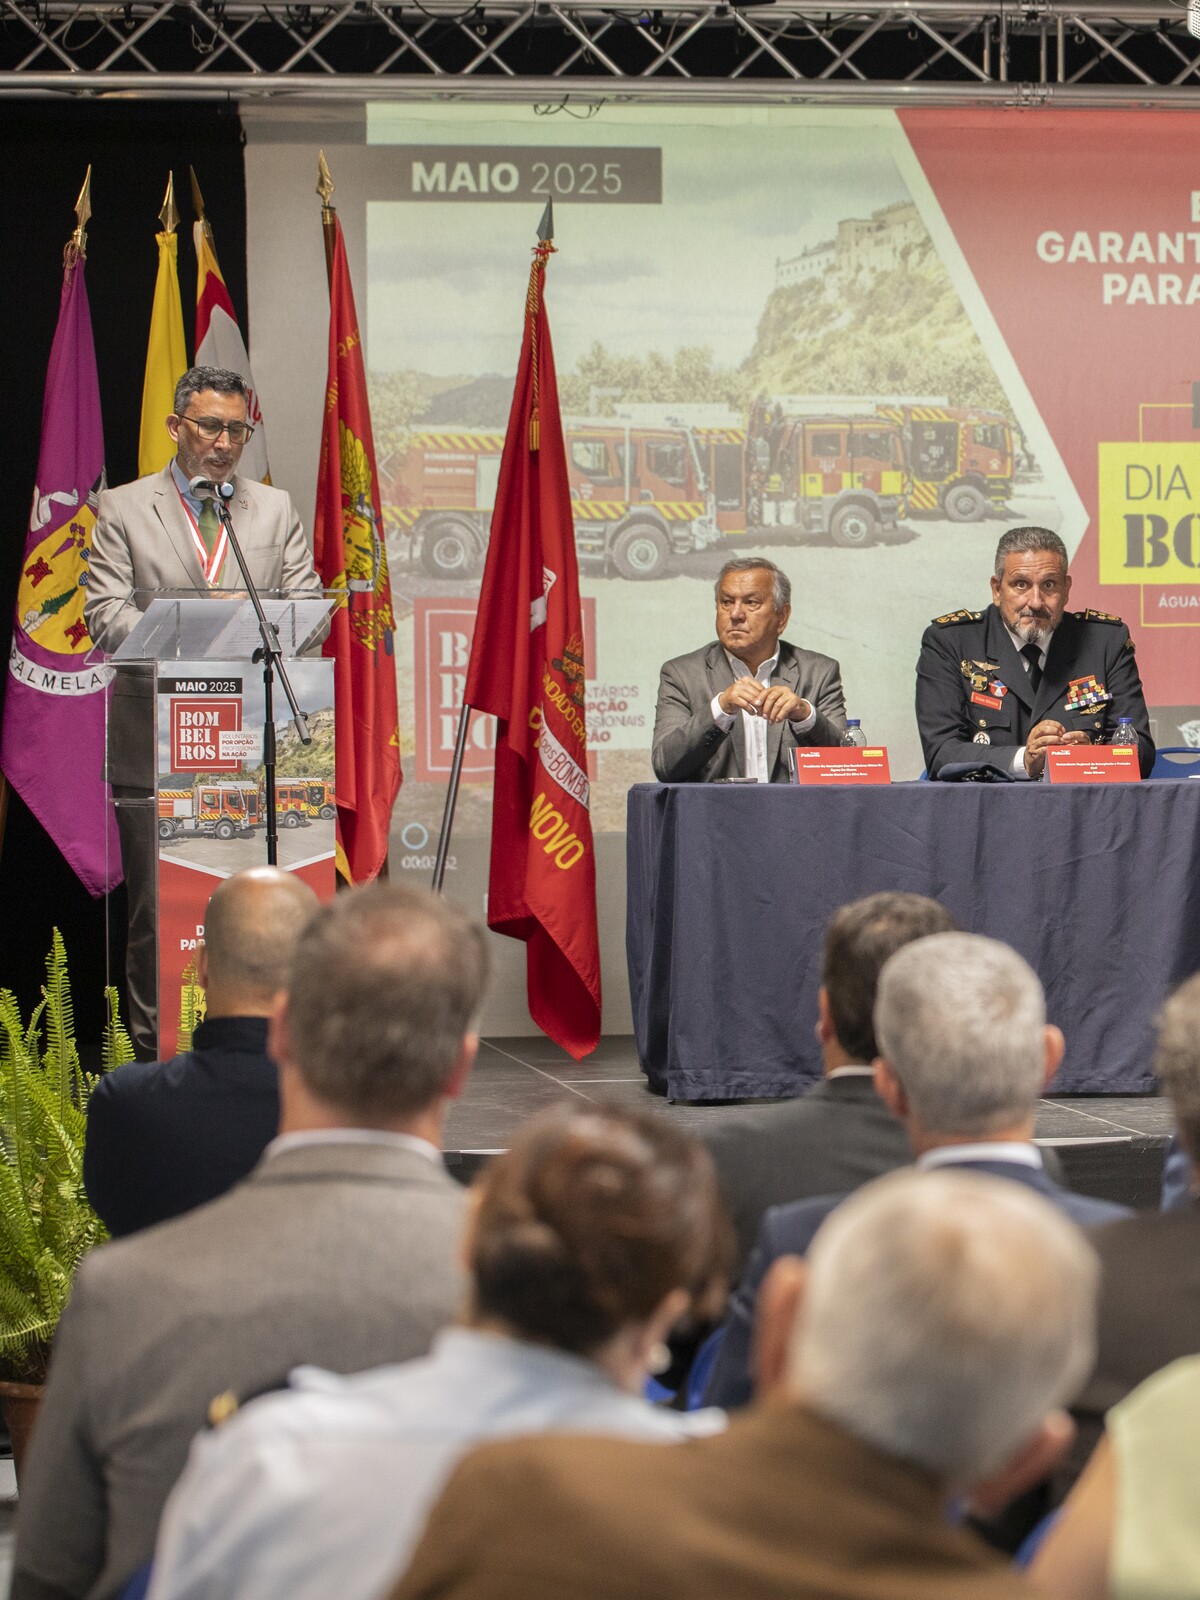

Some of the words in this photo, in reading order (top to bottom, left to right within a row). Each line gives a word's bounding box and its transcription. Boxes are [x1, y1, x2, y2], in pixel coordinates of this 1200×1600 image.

[412, 161, 520, 193] MAIO
[531, 162, 622, 194] 2025
[1125, 464, 1192, 500] DIA
[175, 681, 208, 692] MAIO
[209, 681, 237, 692] 2025
[179, 711, 220, 727] BOM
[179, 728, 212, 743] BEI
[179, 745, 216, 760] ROS
[529, 792, 585, 870] NOVO
